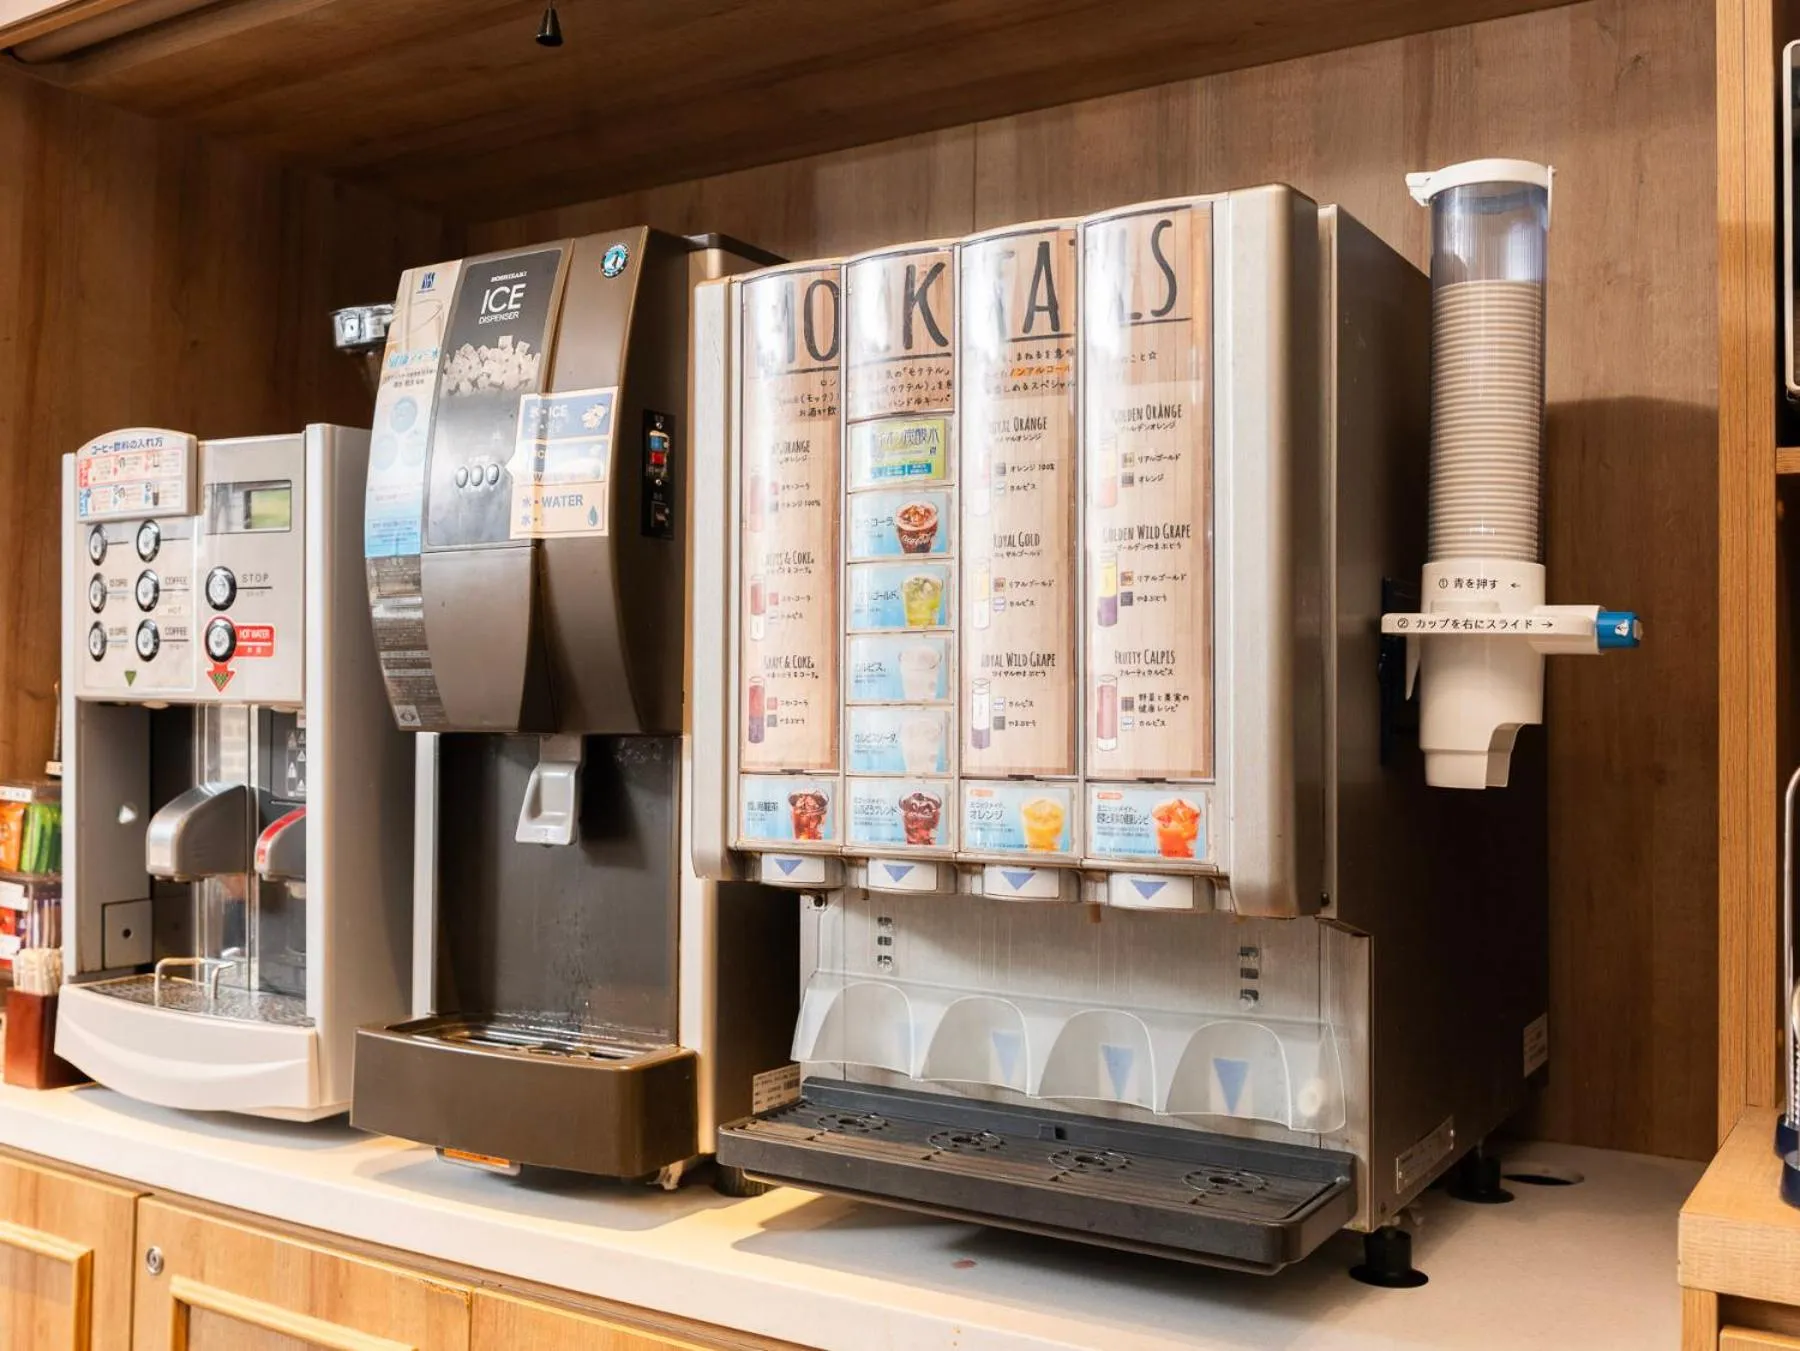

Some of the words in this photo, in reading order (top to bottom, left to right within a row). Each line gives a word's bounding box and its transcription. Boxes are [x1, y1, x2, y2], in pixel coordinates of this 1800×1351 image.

[481, 283, 526, 315] ICE
[479, 311, 519, 325] DISPENSER
[1145, 403, 1182, 420] ORANGE
[1013, 416, 1048, 431] ORANGE
[542, 494, 584, 508] WATER
[1137, 524, 1160, 540] WILD
[1162, 522, 1191, 540] GRAPE
[1018, 531, 1040, 547] GOLD
[241, 573, 269, 583] STOP
[1453, 578, 1498, 590] 青を押す
[1415, 617, 1534, 630] カップを右にスライド
[1006, 652, 1028, 667] WILD
[1029, 651, 1056, 667] GRAPE
[1143, 649, 1176, 665] CALPIS
[969, 808, 1003, 820] オレンジ
